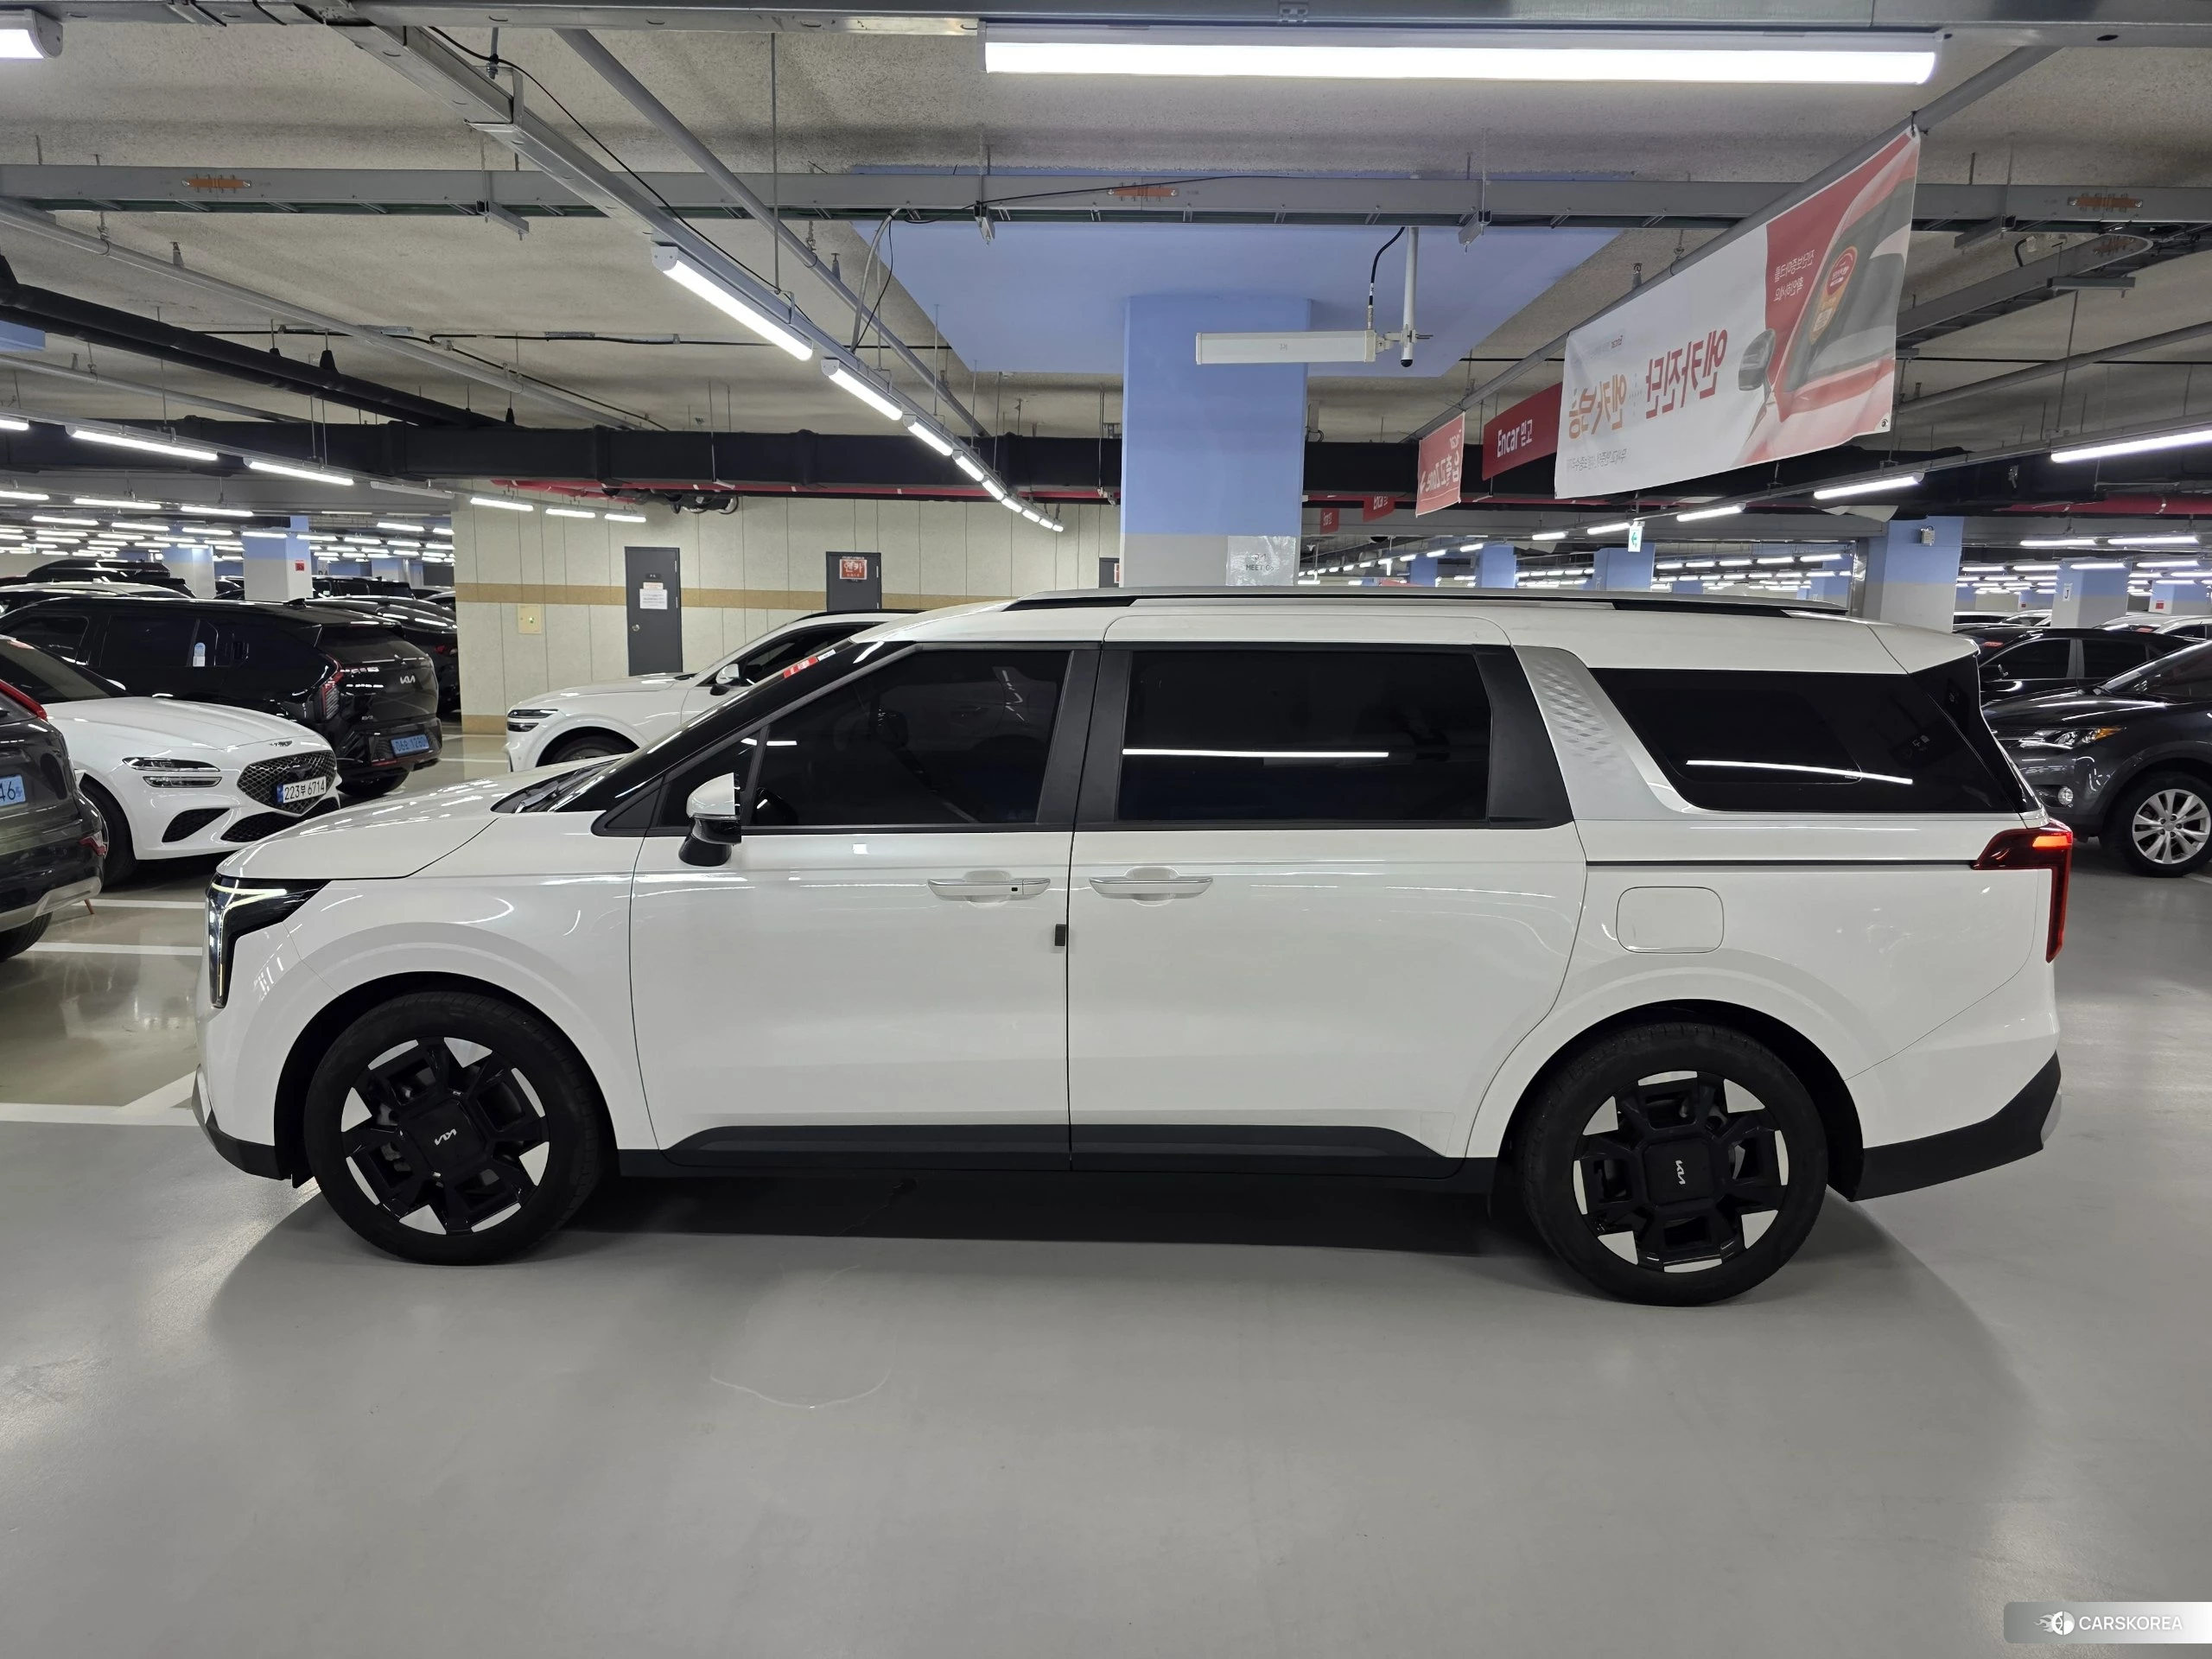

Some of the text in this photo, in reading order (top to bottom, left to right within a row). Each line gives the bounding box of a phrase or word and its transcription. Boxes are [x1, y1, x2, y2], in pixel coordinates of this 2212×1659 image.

[1497, 426, 1521, 458] Encar
[843, 560, 863, 573] 엔카
[2064, 589, 2069, 600] J
[284, 779, 325, 800] 223부 6714
